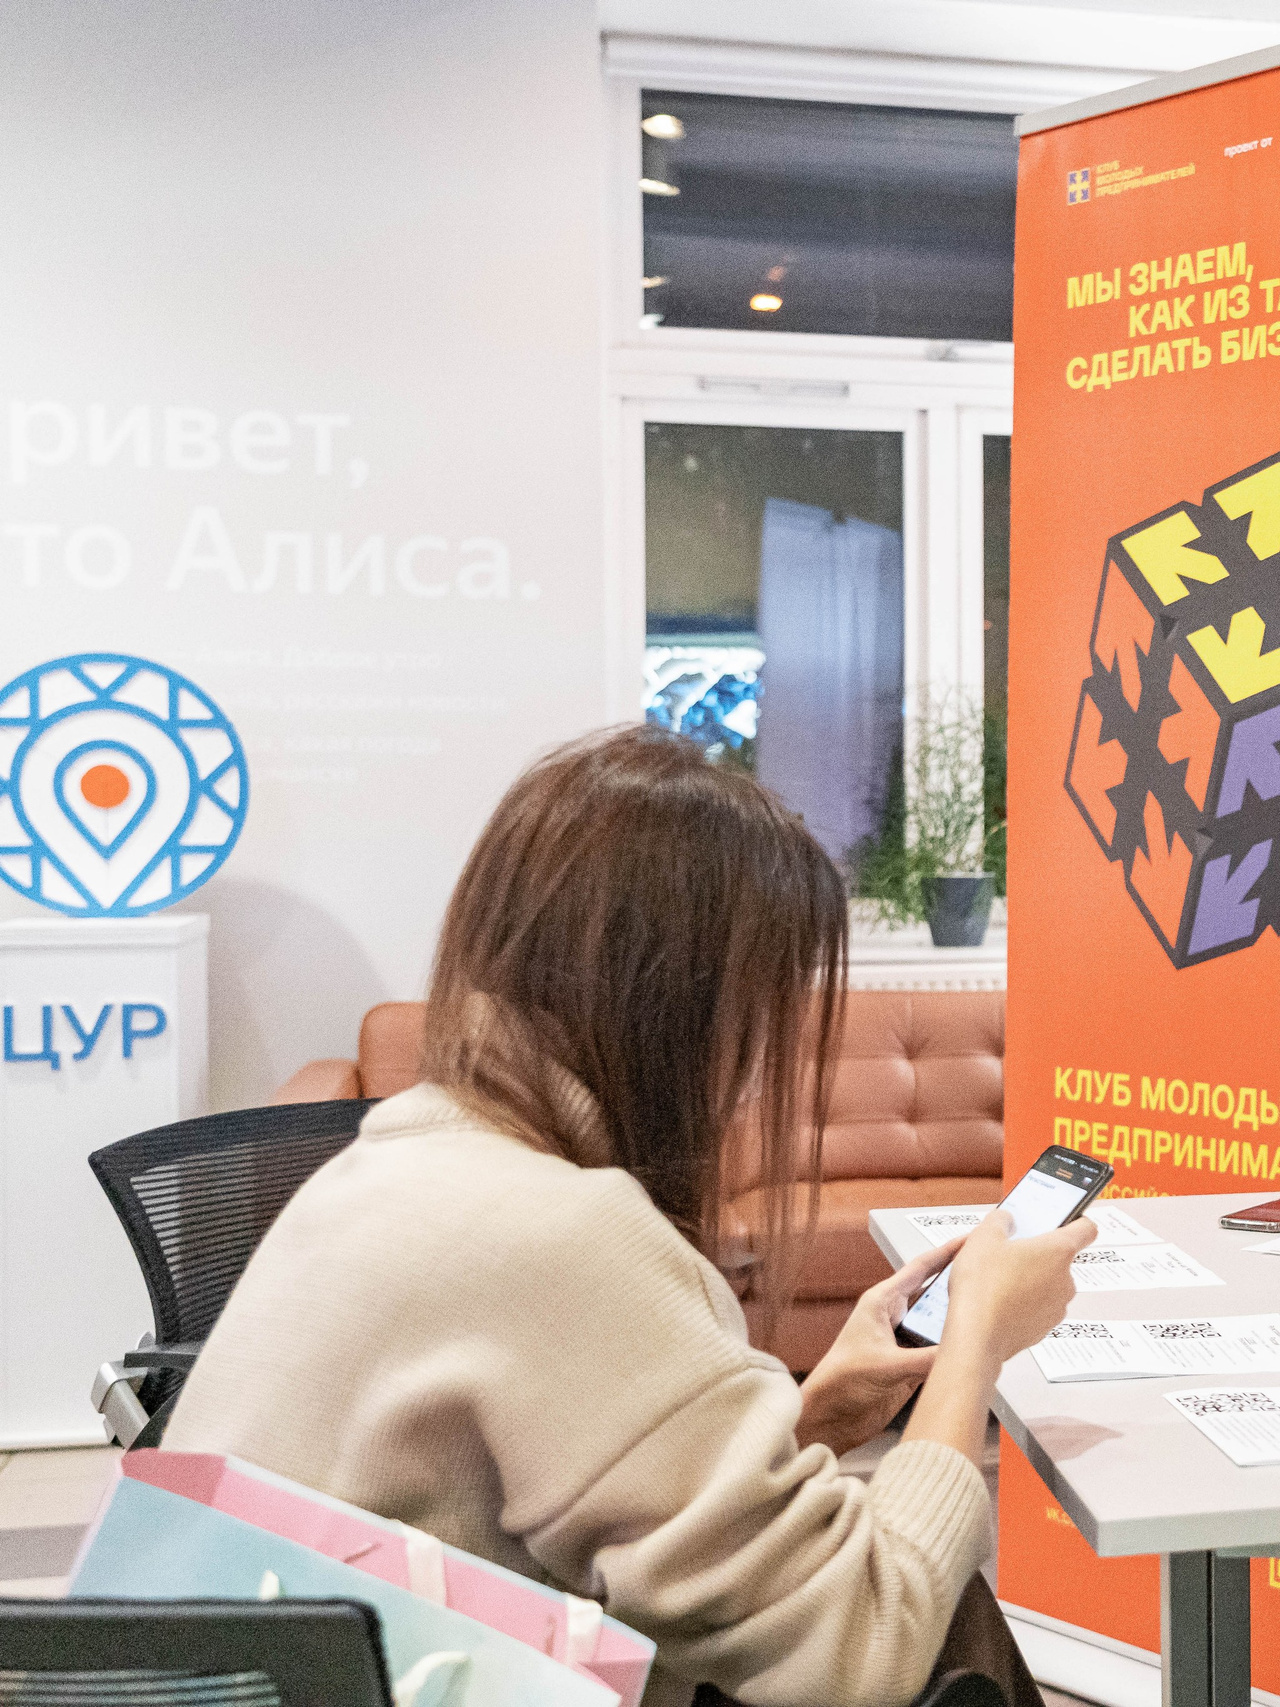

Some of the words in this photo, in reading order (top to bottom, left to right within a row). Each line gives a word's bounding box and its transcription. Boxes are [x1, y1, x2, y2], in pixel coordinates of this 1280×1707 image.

[1260, 136, 1274, 149] от
[1066, 267, 1121, 309] МЫ
[1128, 241, 1254, 296] ЗНАЕМ,
[1128, 295, 1196, 338] КАК
[1203, 285, 1250, 325] ИЗ
[1065, 336, 1212, 393] СДЕЛАТЬ
[8, 397, 371, 490] ривет,
[2, 521, 133, 591] то
[165, 504, 543, 602] Алиса.
[3, 1003, 168, 1071] ЦУР
[1054, 1066, 1132, 1107] КЛУБ
